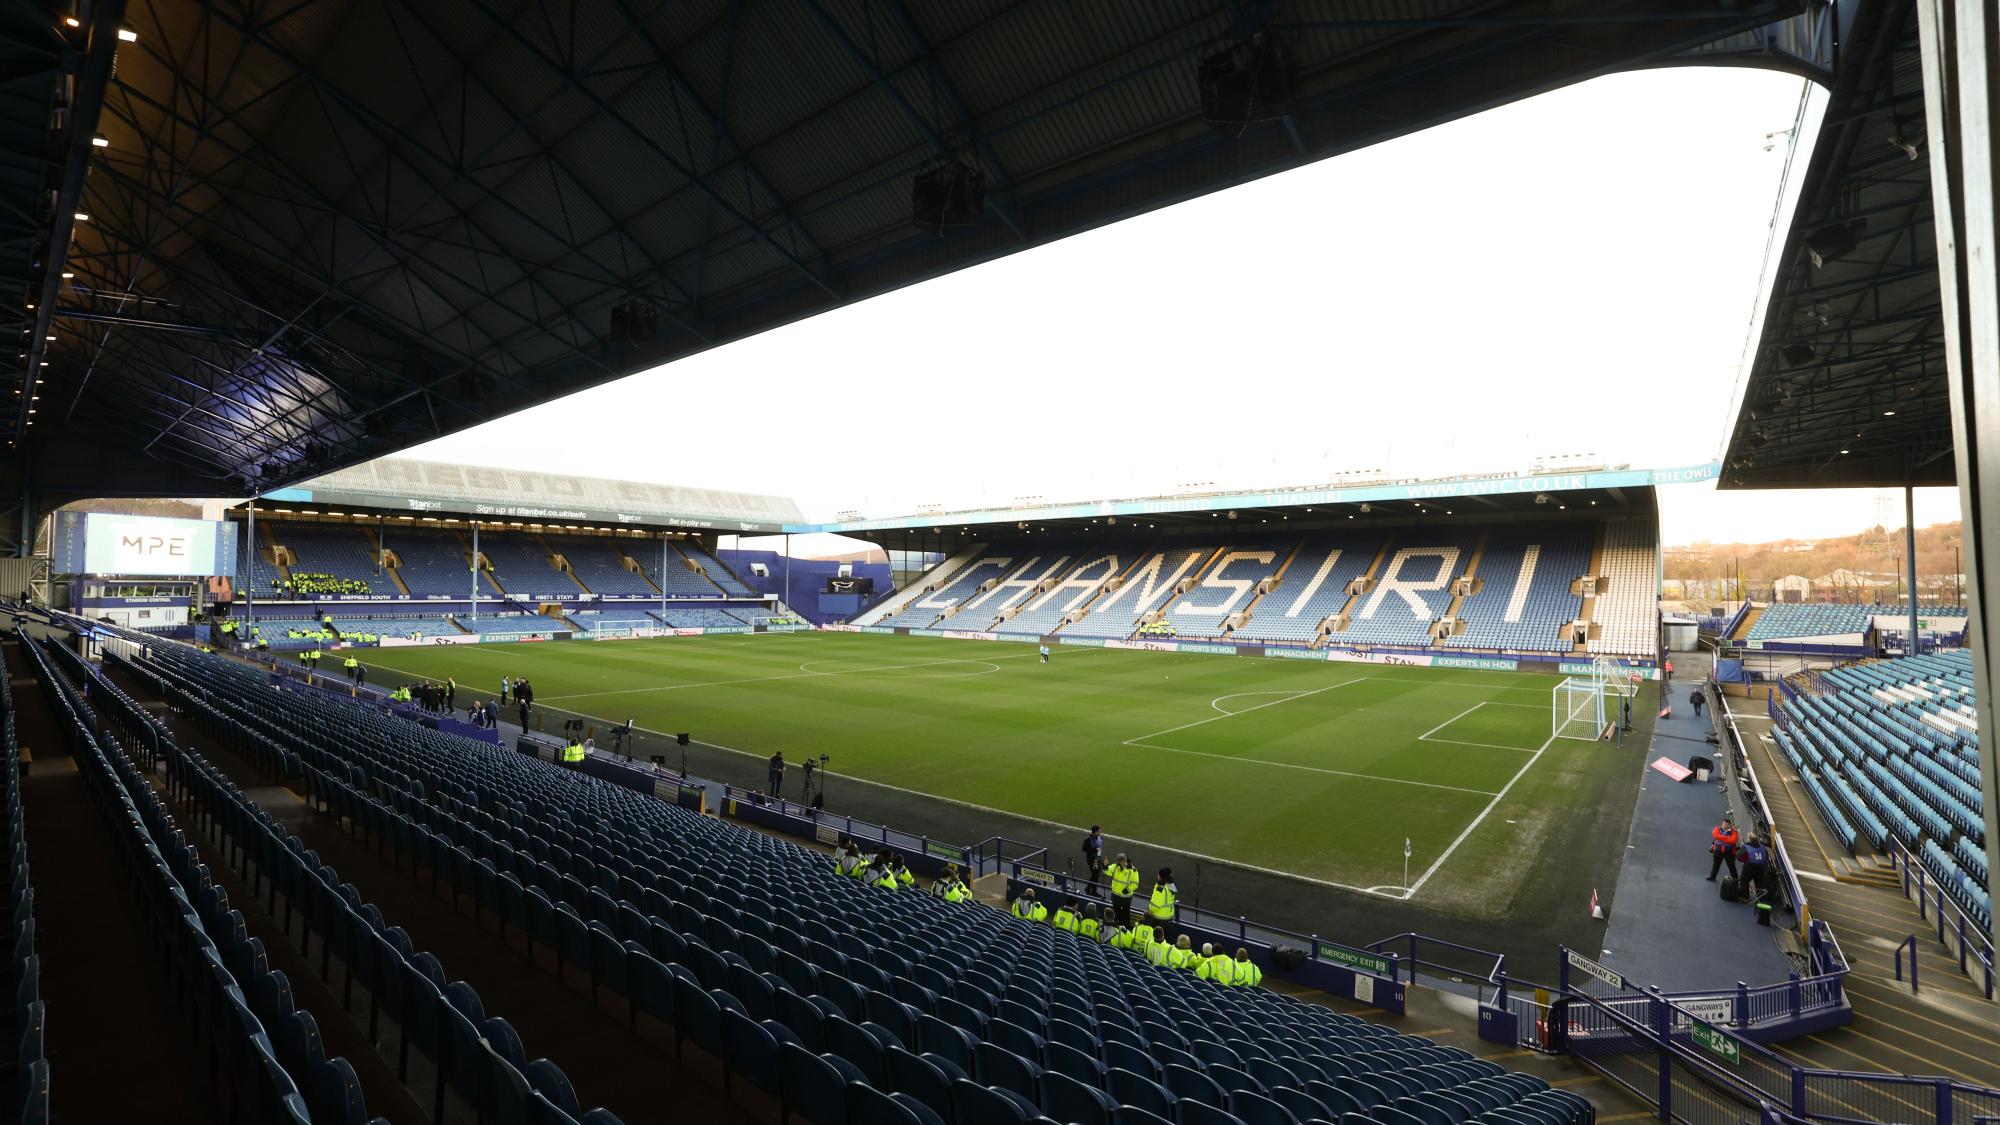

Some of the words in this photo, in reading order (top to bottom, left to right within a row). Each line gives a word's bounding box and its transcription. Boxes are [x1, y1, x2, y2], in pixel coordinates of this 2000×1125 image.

[1653, 471, 1680, 481] THE
[1683, 466, 1712, 480] OWLS
[1408, 475, 1585, 498] WWW.SWFC.CO.UK
[408, 499, 442, 509] Titanbet
[1266, 491, 1341, 506] CHANSIRI
[475, 504, 495, 514] Sign
[495, 507, 506, 515] up
[516, 508, 587, 519] titanbet.co.uk/swfc
[669, 517, 680, 525] Bet
[680, 519, 699, 527] in-play
[65, 527, 74, 574] CHANSIRI
[122, 535, 185, 556] MPE
[915, 545, 1540, 624] CHANSIRI
[1273, 650, 1327, 658] MANAGEMENT
[1438, 658, 1478, 667] EXPERTS
[1480, 660, 1490, 668] IN
[1571, 665, 1650, 677] MANAGEMENT
[1023, 869, 1046, 879] GANGWAY
[1321, 947, 1358, 962] EMERGENCY
[1359, 957, 1375, 967] EXIT
[1570, 955, 1608, 981] GANGWAY
[1609, 974, 1619, 985] 22
[1394, 992, 1404, 1001] 10
[1685, 1003, 1724, 1011] GANGWAYS
[1482, 1011, 1492, 1020] 10
[1693, 1026, 1710, 1041] Exit
